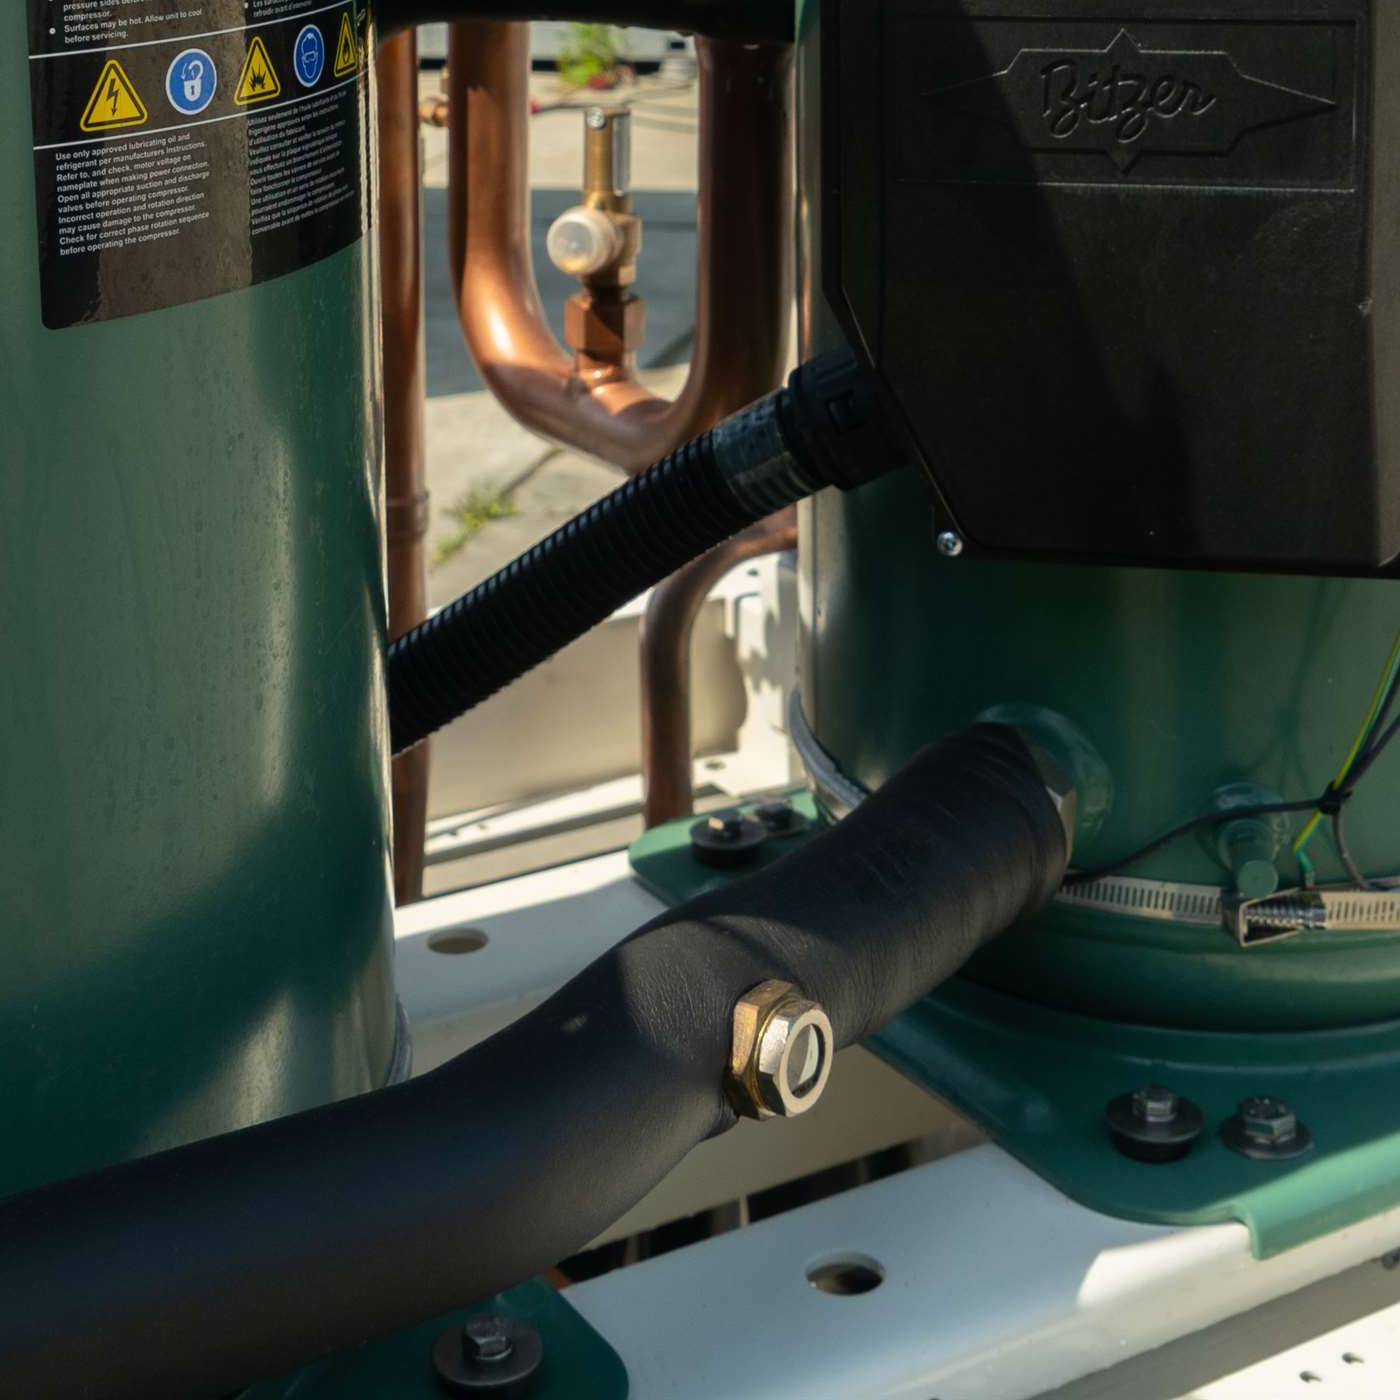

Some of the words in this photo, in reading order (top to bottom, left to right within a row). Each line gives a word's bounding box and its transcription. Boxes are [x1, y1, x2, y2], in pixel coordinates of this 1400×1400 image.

[64, 22, 98, 33] Surfaces
[101, 21, 116, 31] may
[129, 17, 143, 25] hot.
[145, 15, 164, 23] Allow
[166, 12, 178, 20] unit
[188, 9, 202, 17] cool
[65, 34, 90, 44] before
[92, 30, 128, 41] servicing.
[1040, 59, 1216, 143] Bitzer
[56, 153, 71, 161] Use
[73, 150, 90, 159] only
[92, 144, 127, 157] approved
[129, 138, 166, 149] lubricating
[178, 133, 190, 141] and
[57, 160, 97, 172] refrigerant
[99, 158, 111, 166] per
[113, 149, 165, 162] manufacturers
